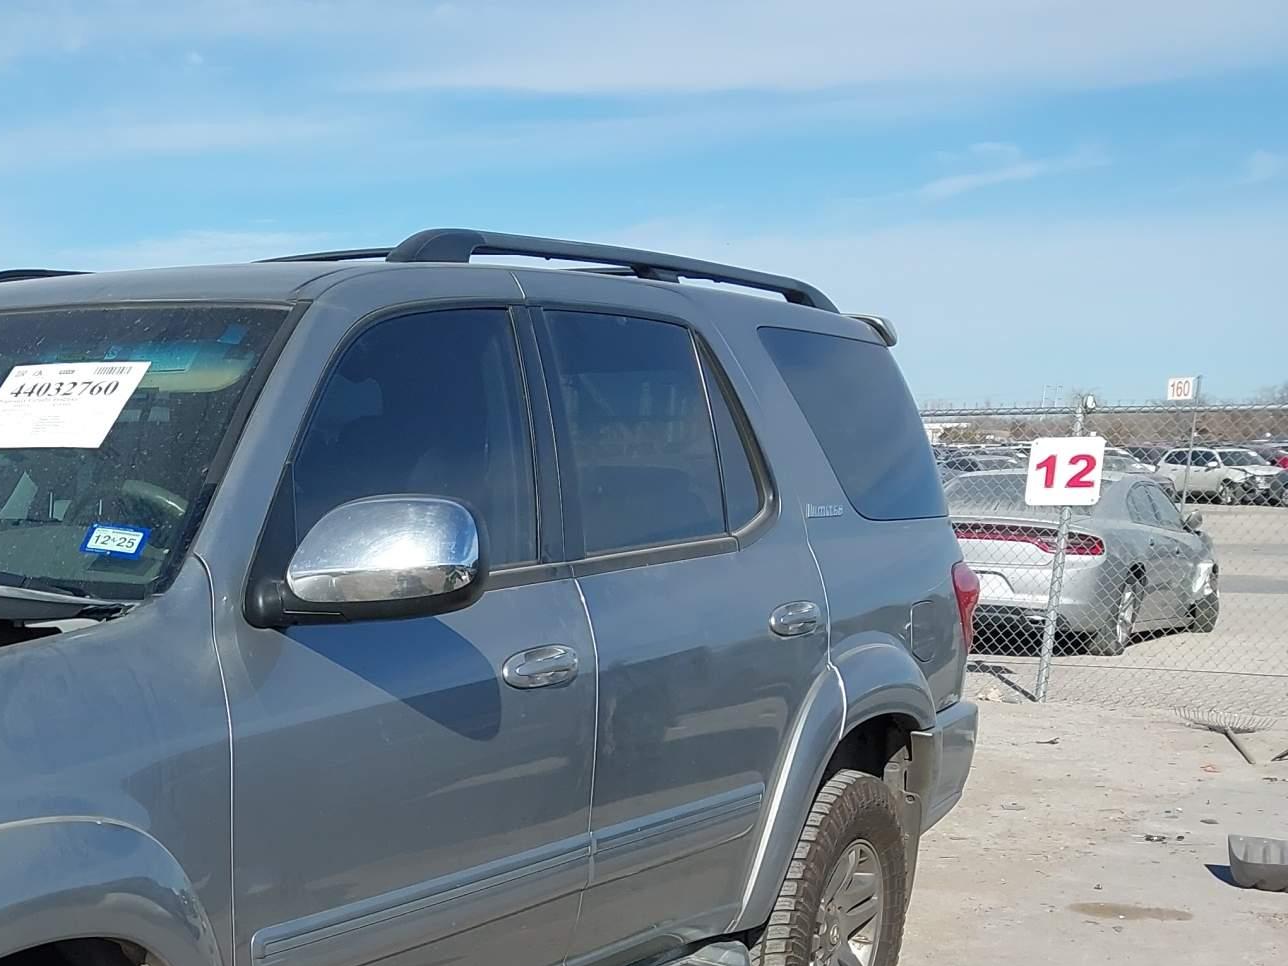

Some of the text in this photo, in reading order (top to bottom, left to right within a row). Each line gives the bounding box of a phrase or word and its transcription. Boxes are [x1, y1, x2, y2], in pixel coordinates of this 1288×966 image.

[9, 380, 120, 398] 44032760
[1170, 380, 1190, 398] 160
[1035, 454, 1097, 489] 12
